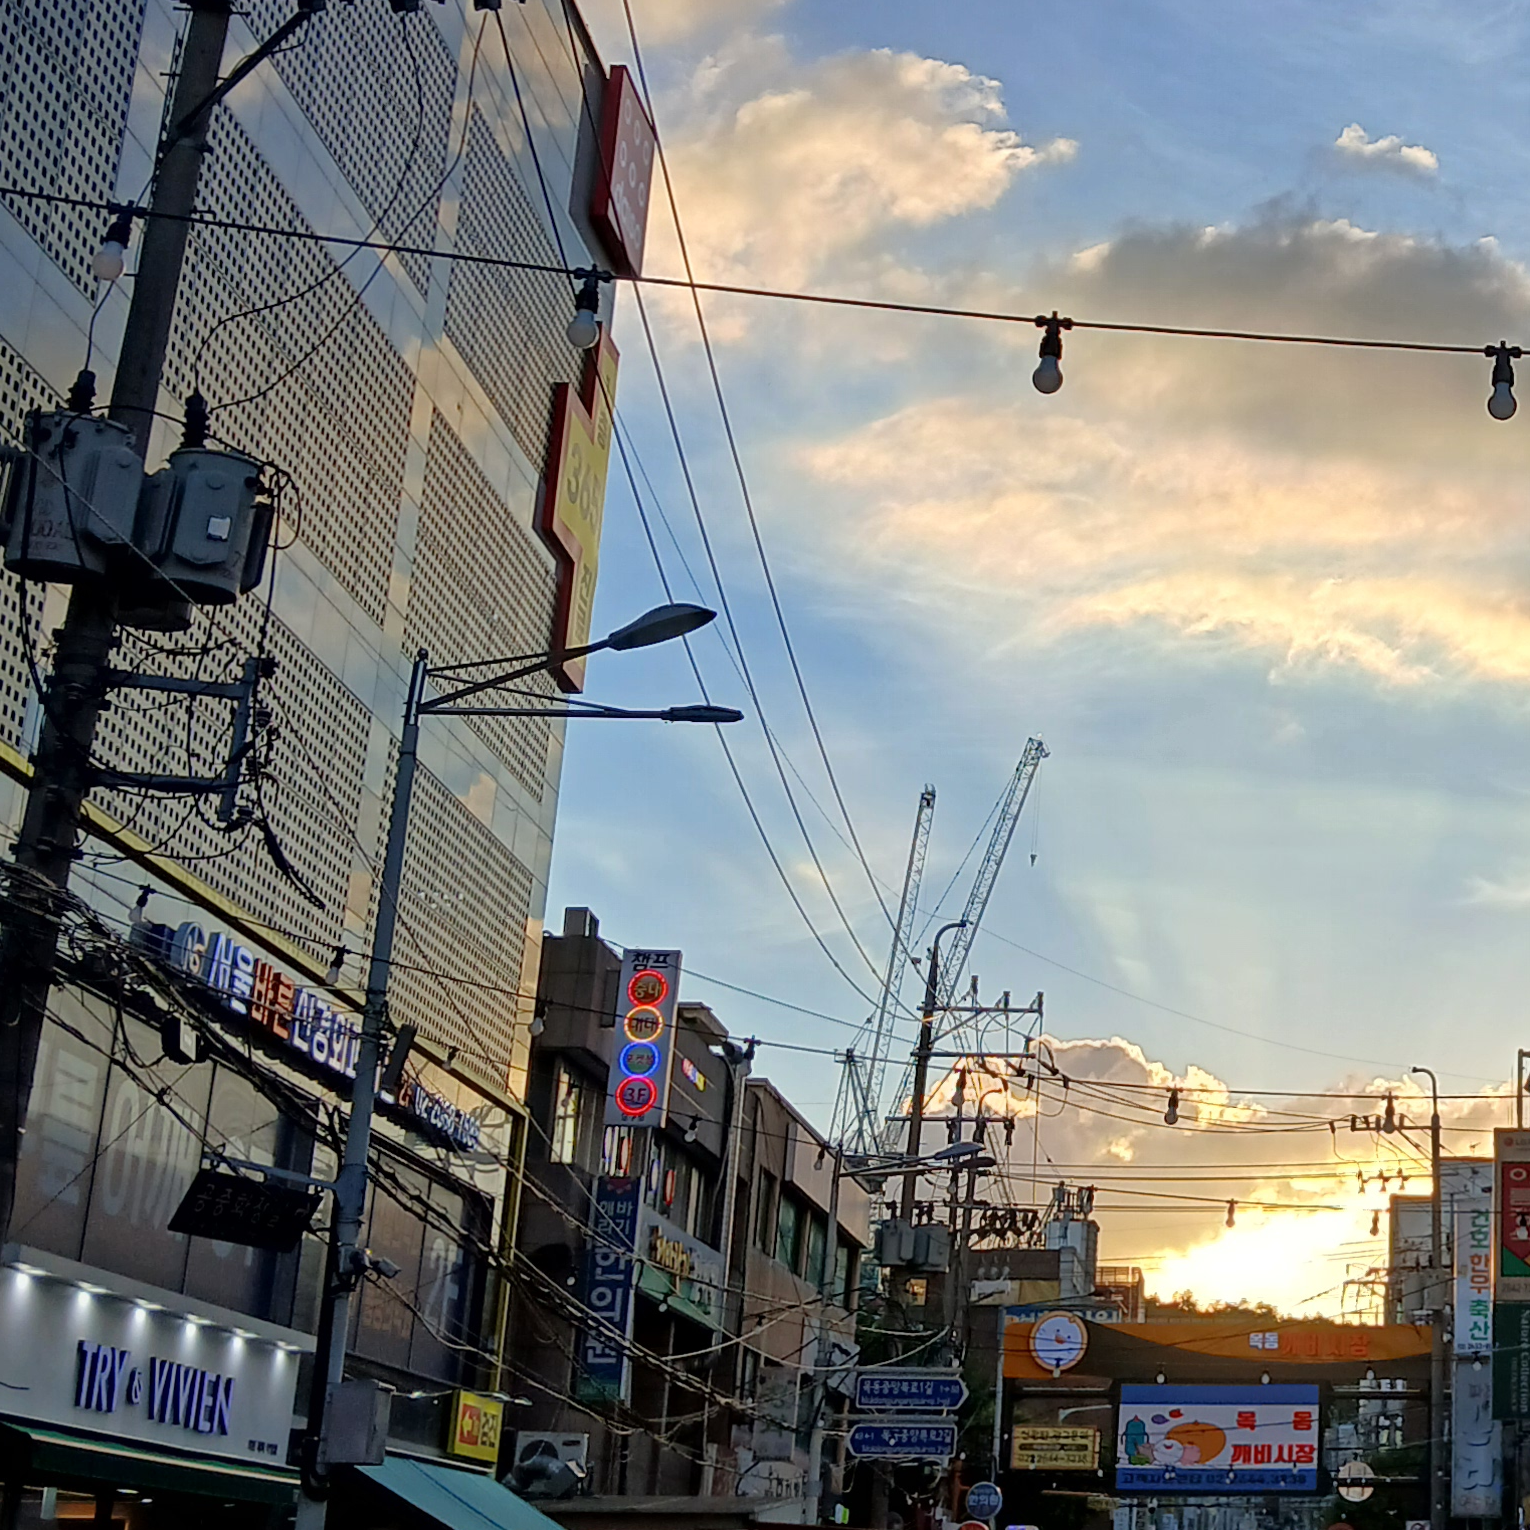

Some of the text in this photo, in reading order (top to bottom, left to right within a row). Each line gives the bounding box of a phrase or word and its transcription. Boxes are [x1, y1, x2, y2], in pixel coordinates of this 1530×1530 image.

[566, 442, 601, 537] 365
[631, 952, 670, 971] 챔프
[633, 981, 662, 999] 중대
[626, 1086, 648, 1103] 3F
[1469, 1299, 1490, 1341] 축산
[1248, 1331, 1371, 1357] 목동 깨비시장
[75, 1339, 236, 1436] TRY & VIVIEN
[1236, 1410, 1313, 1432] 목 동
[1230, 1444, 1316, 1465] 깨비시장
